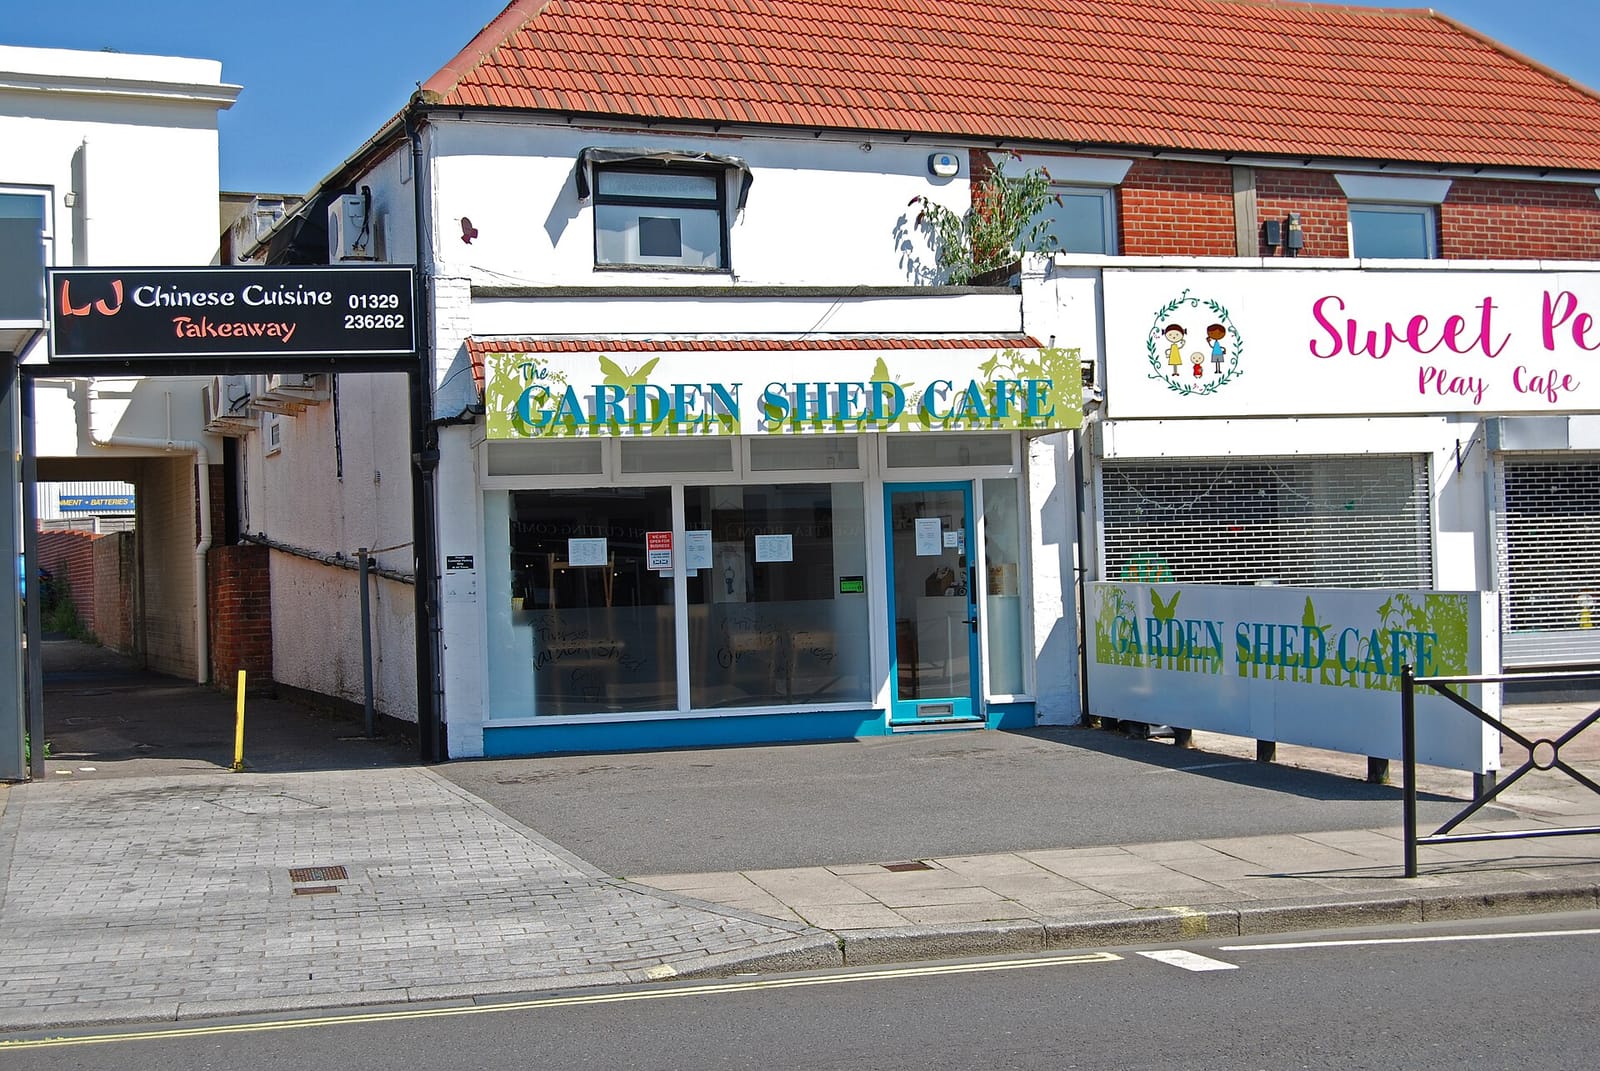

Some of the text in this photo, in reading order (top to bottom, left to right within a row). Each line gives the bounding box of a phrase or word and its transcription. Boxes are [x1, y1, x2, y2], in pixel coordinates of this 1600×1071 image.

[62, 279, 332, 317] LJ Chinese Cuisine
[348, 294, 399, 310] 01329
[172, 316, 296, 343] Takeaway
[344, 314, 405, 330] 236262
[1309, 295, 1512, 359] Sweet
[517, 362, 549, 381] The
[1418, 365, 1581, 405] Play Cafe
[516, 379, 1056, 428] GARDEN SHED CAFE
[90, 498, 129, 506] BATTERIES
[1111, 615, 1440, 678] GARDEN SHED CAFE
